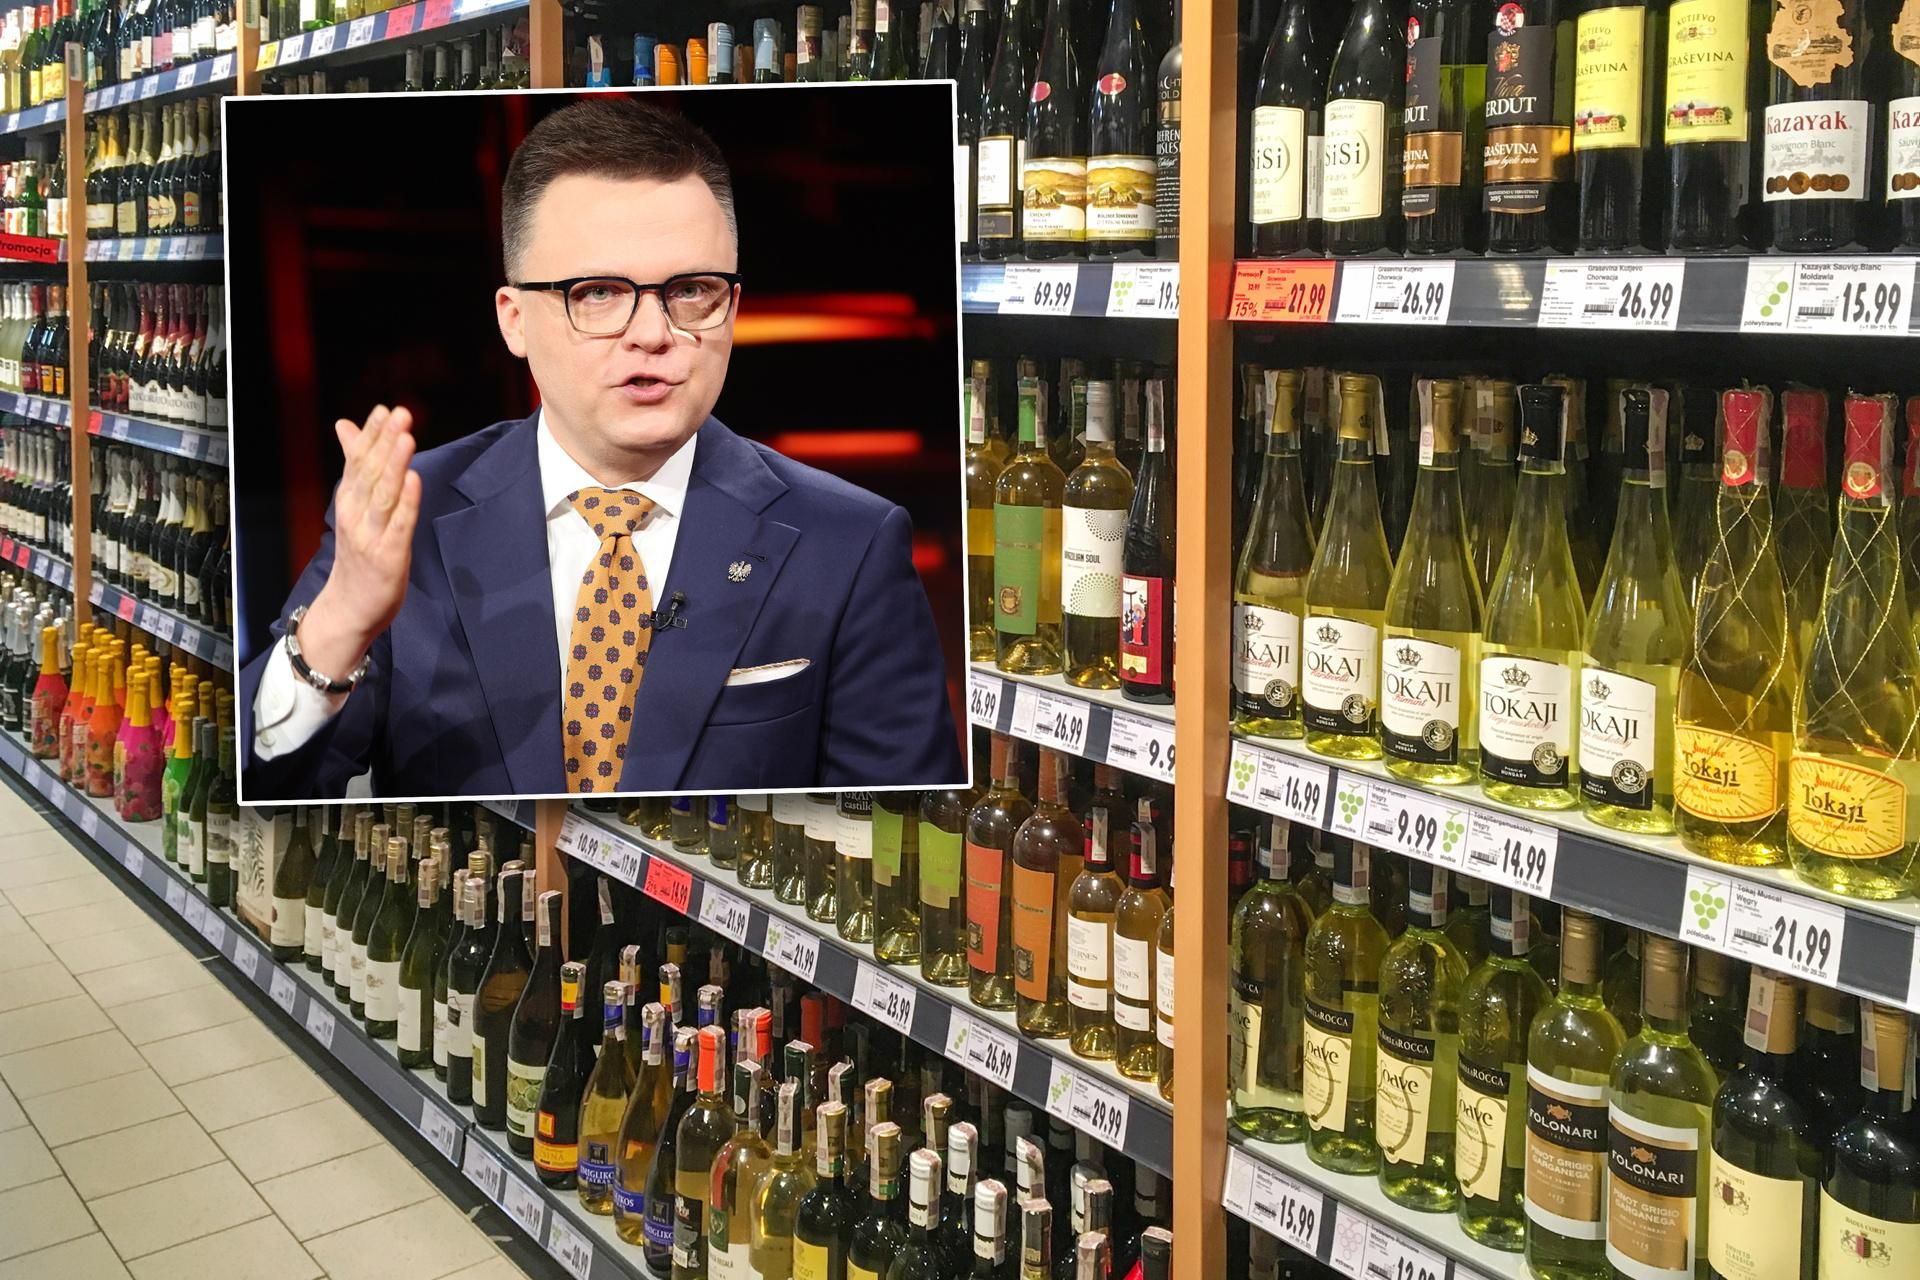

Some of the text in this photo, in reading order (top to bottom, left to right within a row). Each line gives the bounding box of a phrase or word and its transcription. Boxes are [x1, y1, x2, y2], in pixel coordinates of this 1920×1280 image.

[1767, 111, 1848, 135] Kazayak
[0, 241, 51, 258] romocja
[1801, 263, 1832, 271] Kazayak
[1034, 281, 1072, 307] 69.99
[1235, 301, 1259, 318] 15%
[1288, 282, 1327, 315] 27.99
[1401, 281, 1445, 316] 26.99
[1619, 281, 1674, 321] 26.99
[1842, 282, 1902, 325] 15.99
[1085, 553, 1101, 564] SOUL
[971, 688, 997, 719] 26.99
[1484, 691, 1559, 728] TOKAJI
[1054, 711, 1084, 745] 26.99
[1501, 770, 1527, 779] HUNGARY
[1683, 751, 1738, 787] Tokaji
[1285, 775, 1321, 815] 16.99
[1802, 783, 1865, 823] Tokaji
[577, 832, 599, 858] 10.99
[1397, 808, 1438, 852] 9.99
[620, 853, 638, 879] 17.99
[1502, 837, 1547, 884] 14.99
[1736, 893, 1759, 907] Węgry
[726, 907, 746, 937] 21.99
[793, 943, 815, 974] 21.99
[1772, 915, 1832, 971] 21.99
[886, 991, 911, 1025] 23.99
[985, 1042, 1012, 1079] 26.99
[1091, 1098, 1122, 1139] 29.99
[1530, 1108, 1598, 1140] TOLONARI
[1533, 1155, 1590, 1179] GARGANEGA
[1557, 1157, 1593, 1172] GRIGIO
[1612, 1149, 1684, 1185] TOLONARI
[1279, 1194, 1315, 1242] 15.99
[1616, 1198, 1676, 1227] GARGANEGA
[1641, 1204, 1680, 1218] GRIGIO
